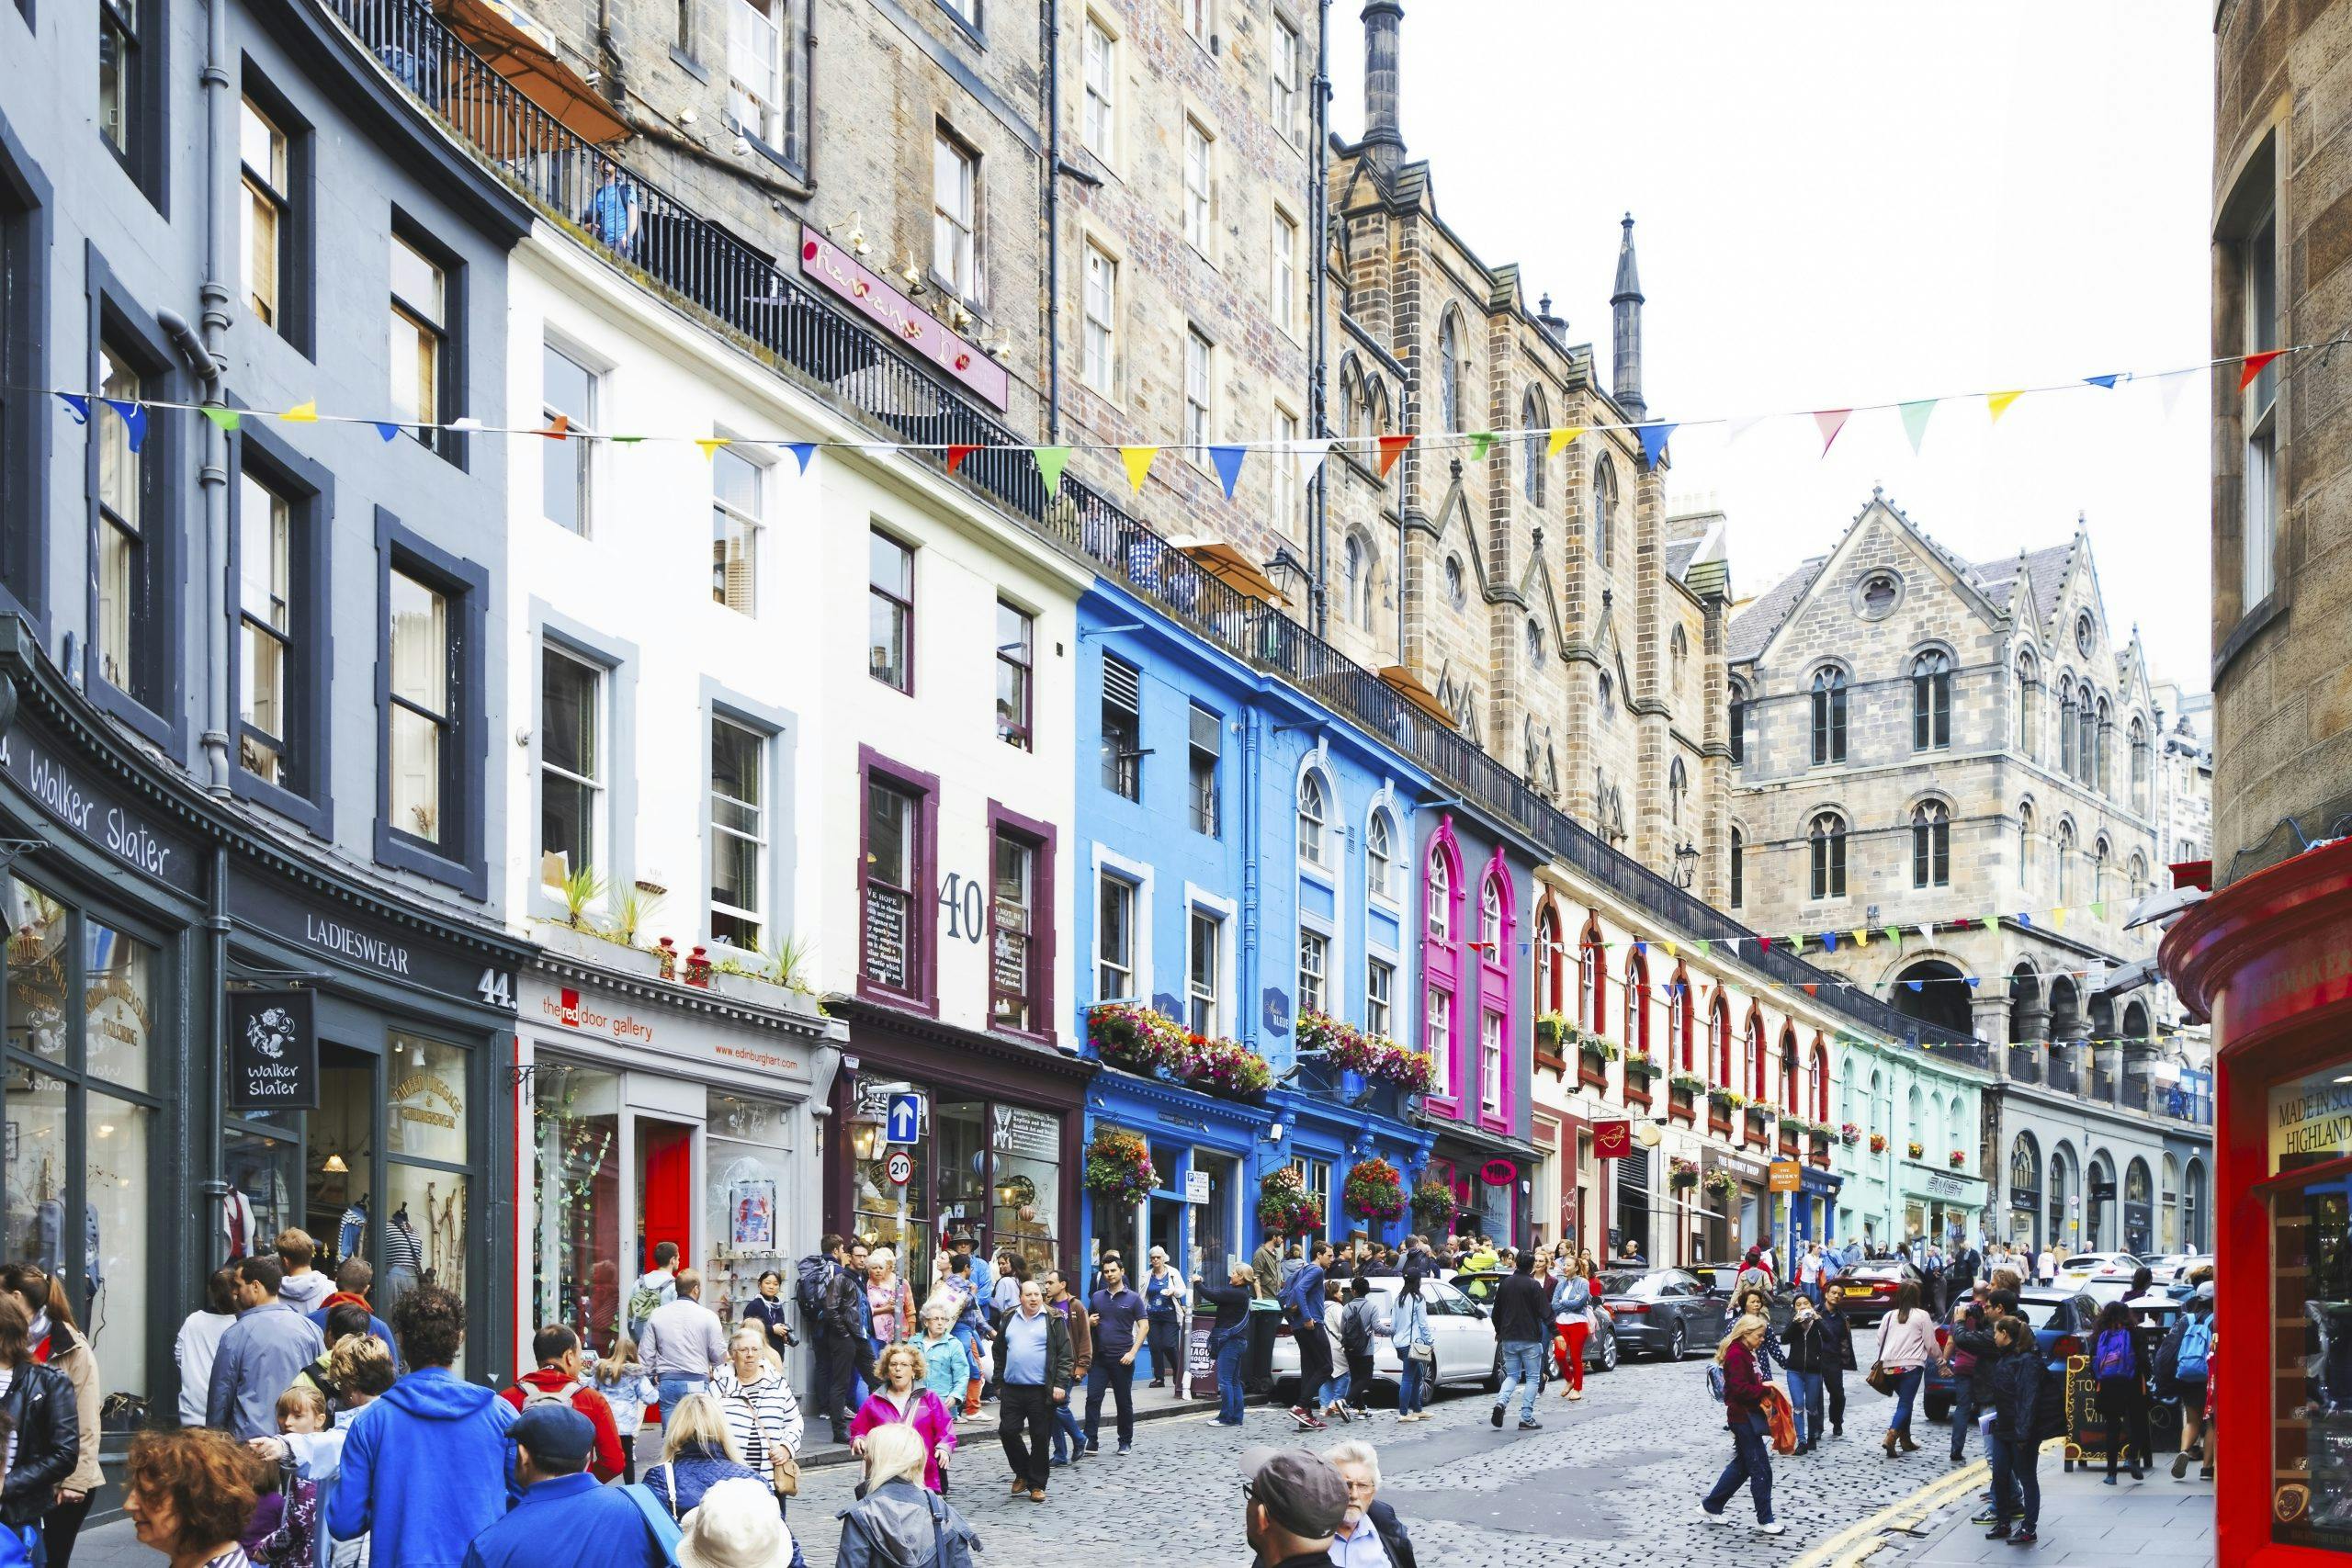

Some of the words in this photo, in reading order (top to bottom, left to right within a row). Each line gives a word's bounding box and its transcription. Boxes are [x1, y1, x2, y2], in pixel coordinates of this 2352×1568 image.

[30, 749, 95, 831] Walker
[107, 806, 171, 877] Slater
[867, 887, 877, 899] VE
[878, 893, 898, 906] HOPE
[938, 872, 984, 944] 40
[1000, 908, 1012, 918] NOT
[1013, 912, 1022, 921] BE
[995, 914, 1015, 927] AFRAID
[307, 914, 410, 975] LADIESWEAR
[543, 997, 561, 1017] the
[561, 1003, 580, 1022] red
[581, 1009, 607, 1028] door
[613, 1016, 653, 1042] gallery
[1272, 1014, 1289, 1029] BLEUE
[248, 1063, 299, 1077] walker
[2278, 1095, 2314, 1129] MADE
[2315, 1089, 2331, 1116] IN
[1717, 1155, 1727, 1167] THE
[1727, 1157, 1747, 1171] WHISKY
[1747, 1164, 1759, 1177] SHOP
